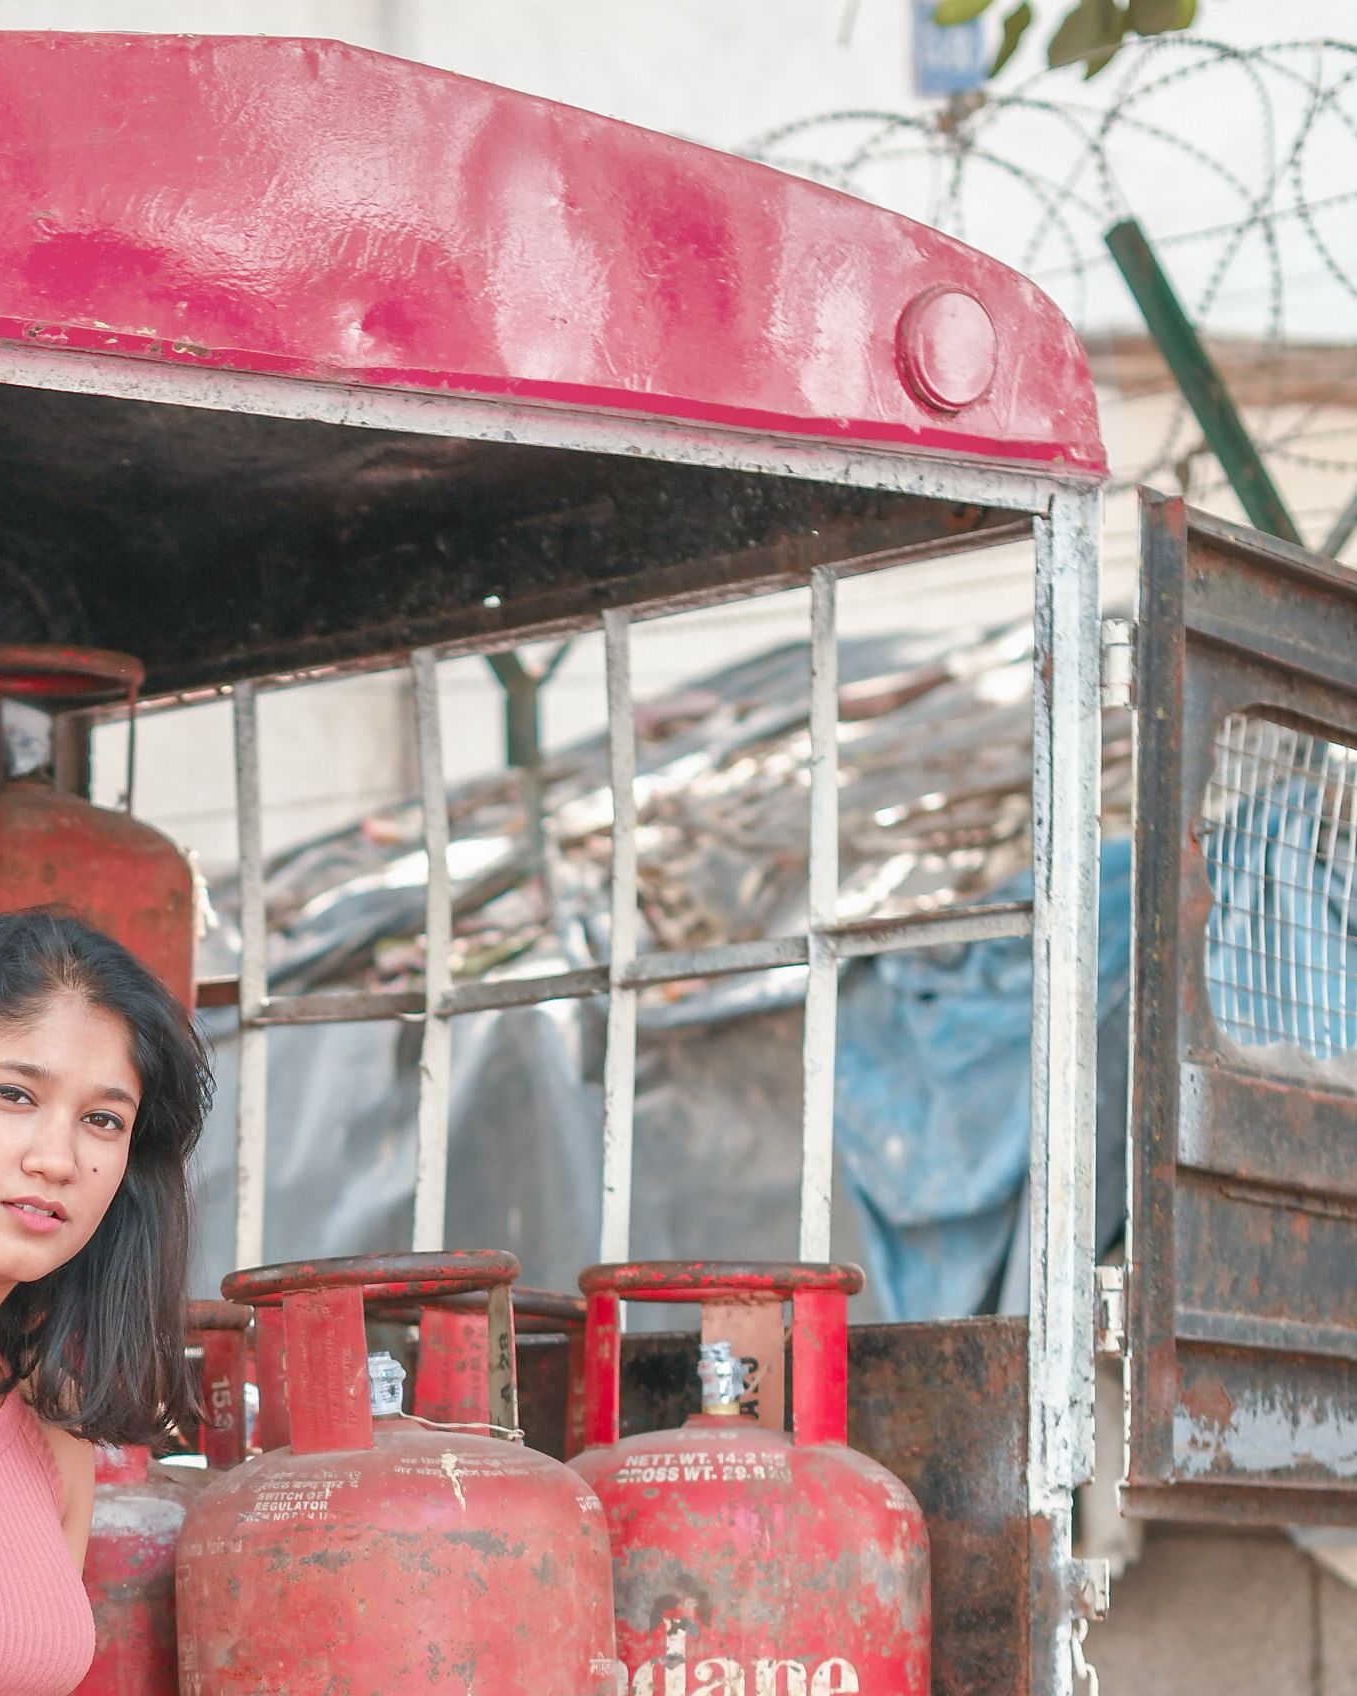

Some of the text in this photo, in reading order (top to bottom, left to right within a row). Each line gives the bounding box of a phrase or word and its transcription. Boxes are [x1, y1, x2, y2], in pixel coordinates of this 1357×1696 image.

[716, 1452, 757, 1464] 14.2
[257, 1491, 303, 1501] SWITCH
[254, 1501, 328, 1511] REGULATOR
